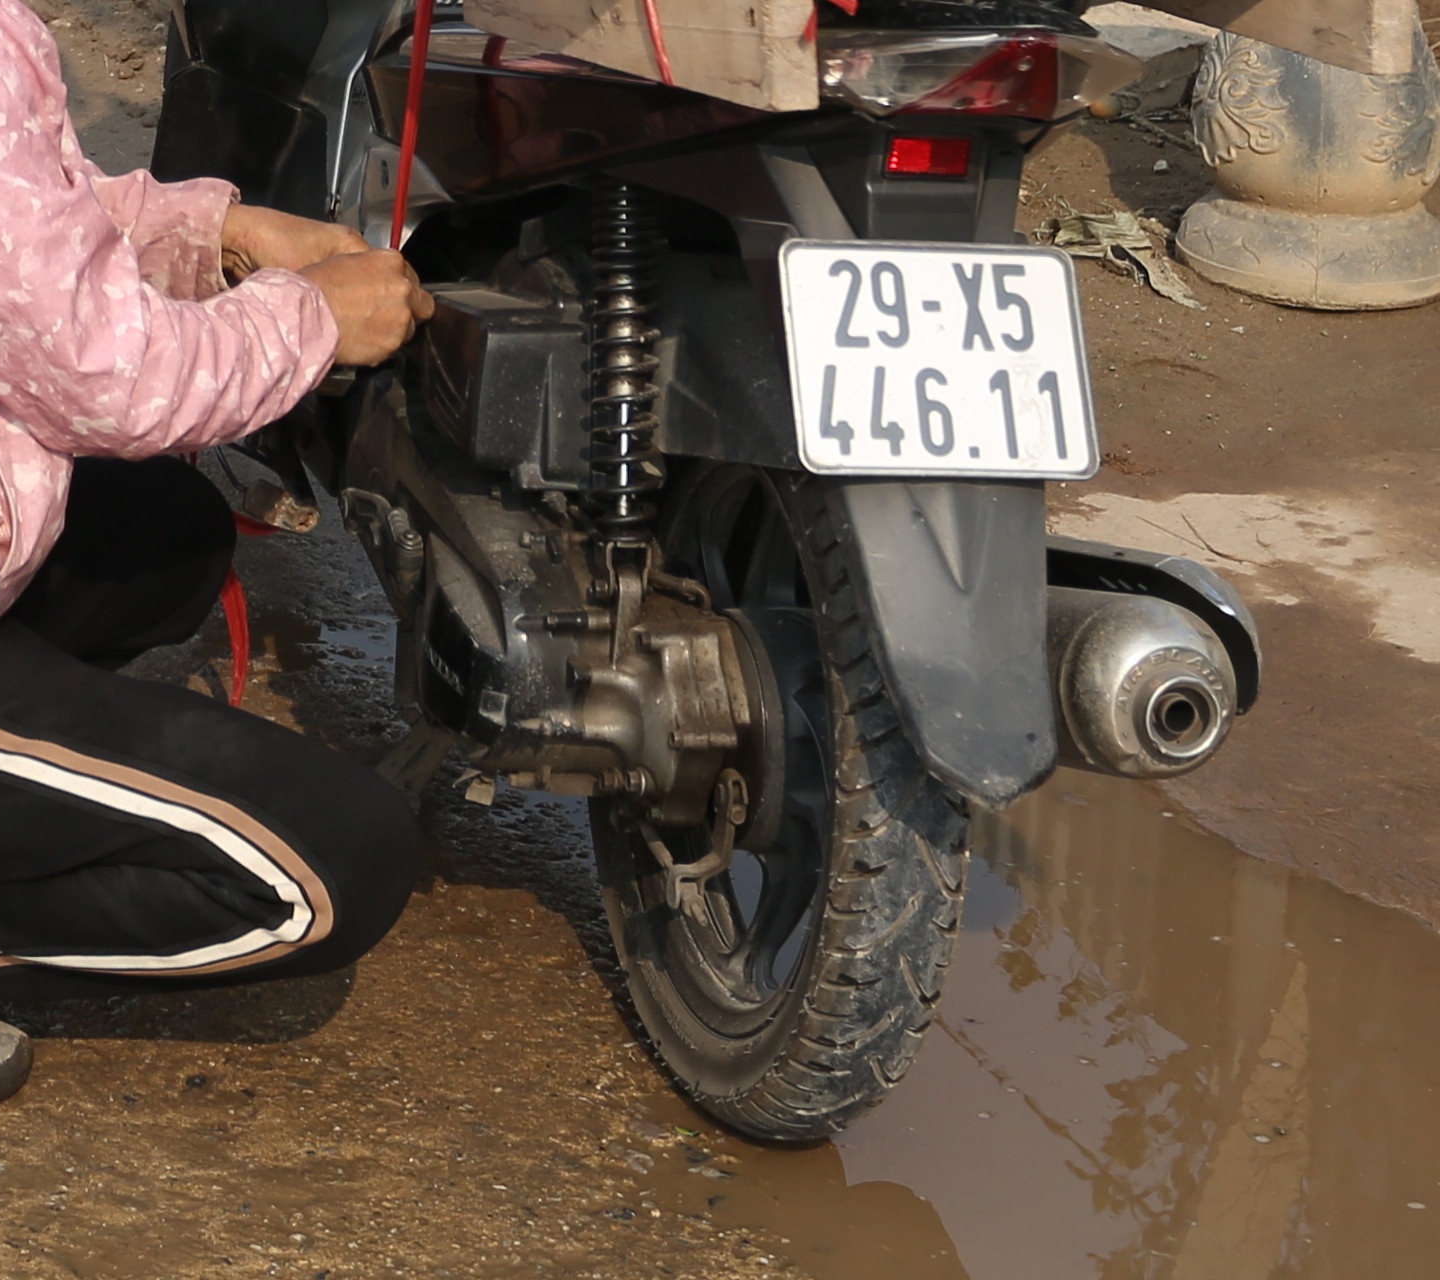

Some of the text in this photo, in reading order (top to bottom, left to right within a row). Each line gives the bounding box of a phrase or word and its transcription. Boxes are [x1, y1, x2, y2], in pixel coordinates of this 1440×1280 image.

[827, 259, 1034, 352] 29-X5
[819, 364, 1068, 460] 446.11
[1117, 666, 1143, 713] AIR
